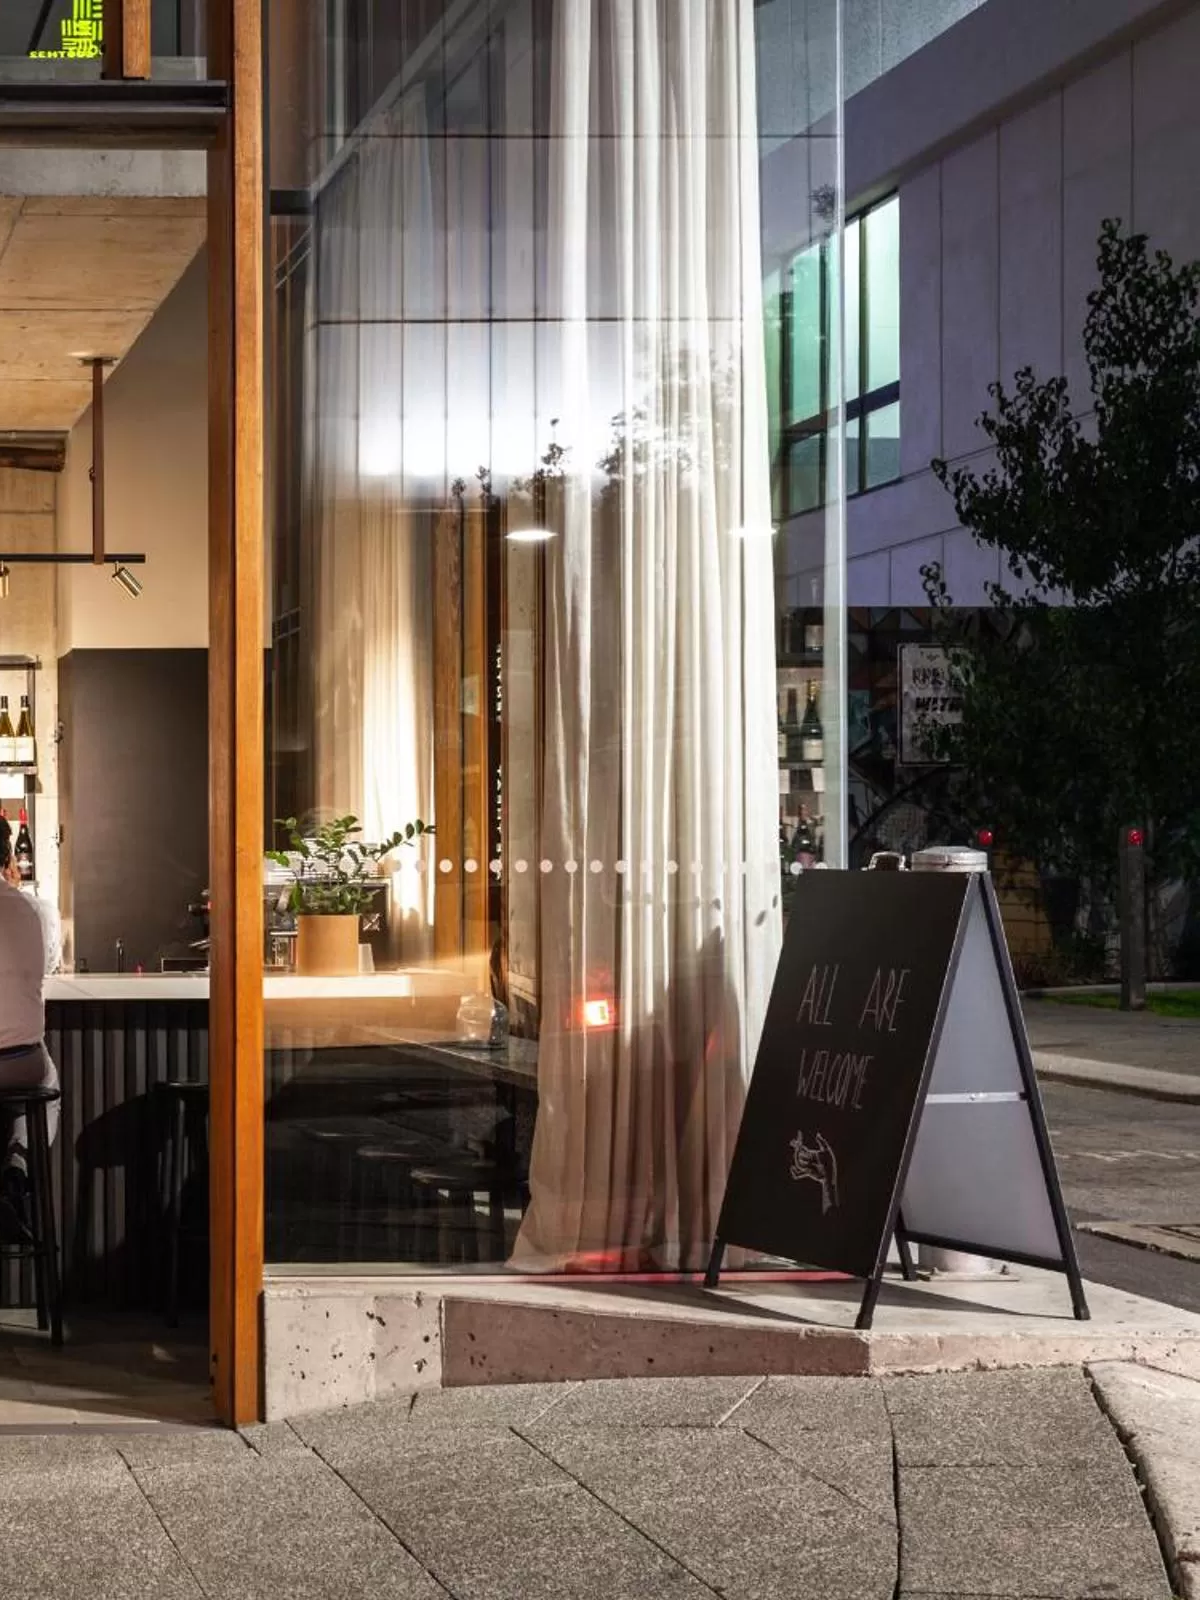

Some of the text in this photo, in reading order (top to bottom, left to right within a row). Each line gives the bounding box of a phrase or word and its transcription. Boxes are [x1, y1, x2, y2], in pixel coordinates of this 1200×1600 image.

[797, 964, 910, 1031] ALL ARE
[797, 1050, 874, 1109] WELCOME
